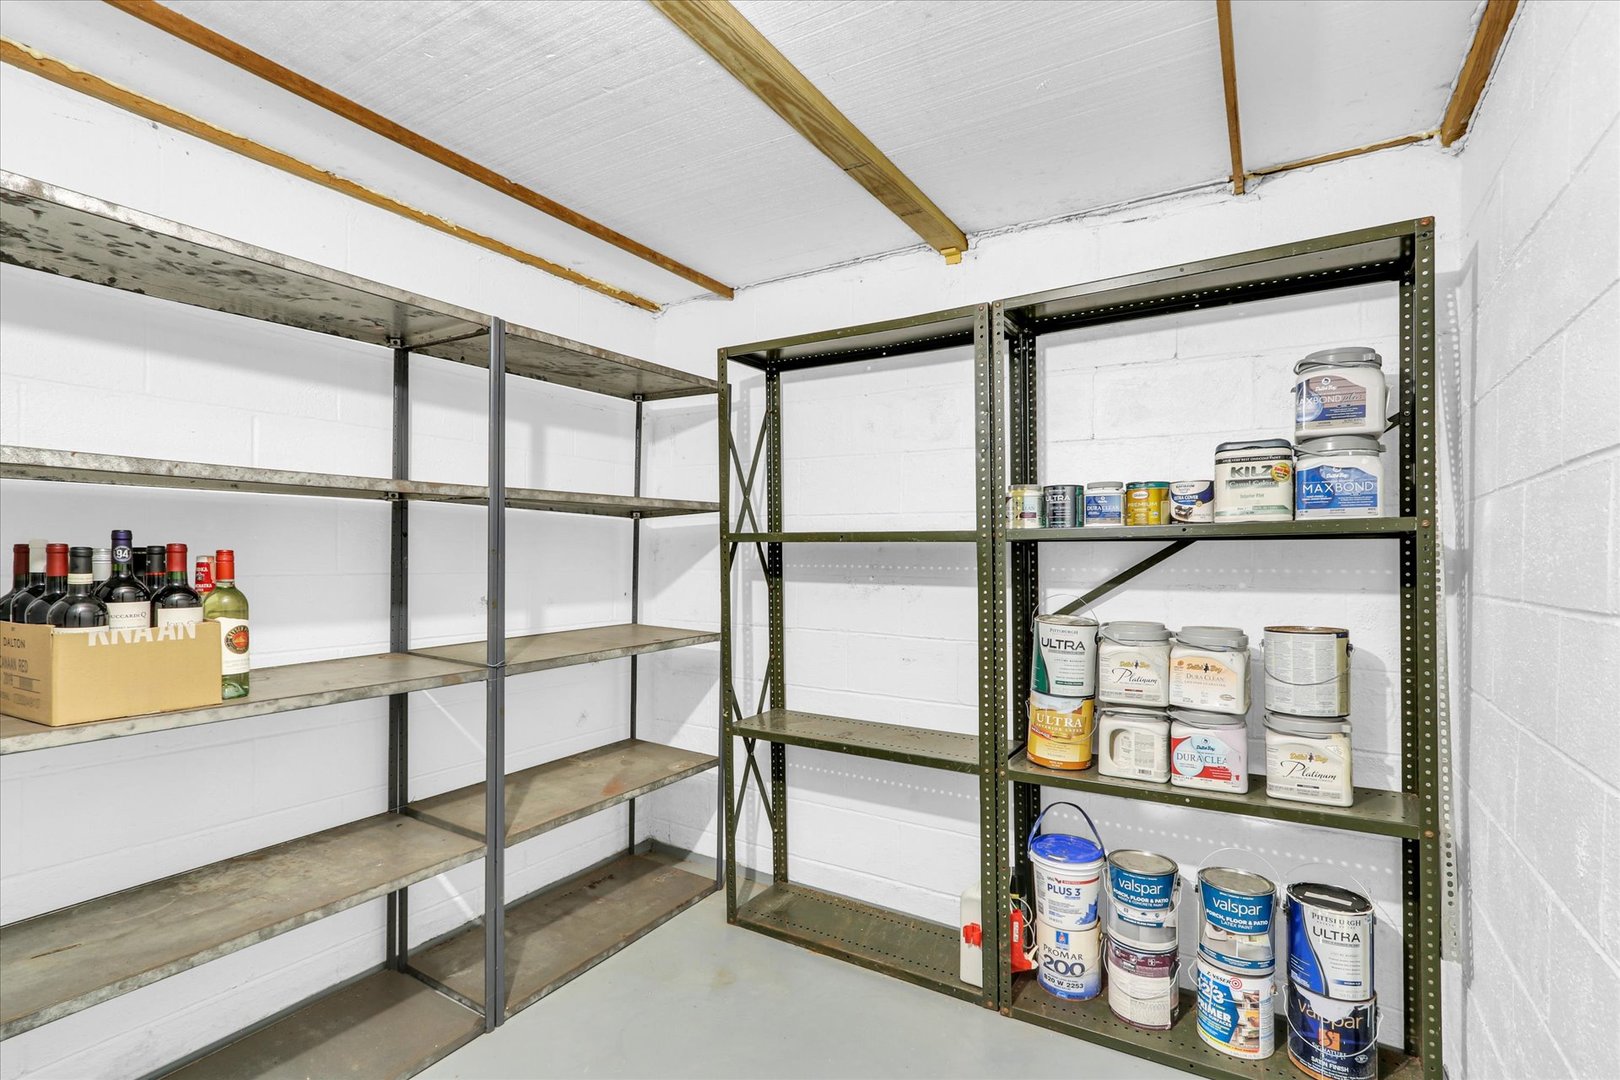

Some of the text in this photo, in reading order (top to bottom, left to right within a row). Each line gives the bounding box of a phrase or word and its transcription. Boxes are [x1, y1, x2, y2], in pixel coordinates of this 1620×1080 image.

[1299, 394, 1342, 405] AXBOND
[1230, 464, 1273, 478] KILZ
[1302, 481, 1374, 494] MAXBOND
[1045, 494, 1071, 502] ULTRA
[116, 549, 129, 559] 94
[3, 636, 26, 649] DALTON
[1041, 636, 1086, 651] ULTRA
[1111, 667, 1158, 684] Platinum
[1036, 712, 1083, 728] ULTRA
[1280, 760, 1337, 780] Platinum
[1046, 883, 1081, 897] PLUS 3
[1118, 877, 1164, 897] valspar
[1212, 896, 1263, 917] valspar
[1220, 920, 1238, 929] LATEX
[1225, 916, 1248, 926] FLOOR
[1312, 926, 1361, 943] ULTRA
[1043, 943, 1084, 961] PROMAR
[1043, 953, 1086, 978] 200
[1329, 1062, 1350, 1073] FINISH
